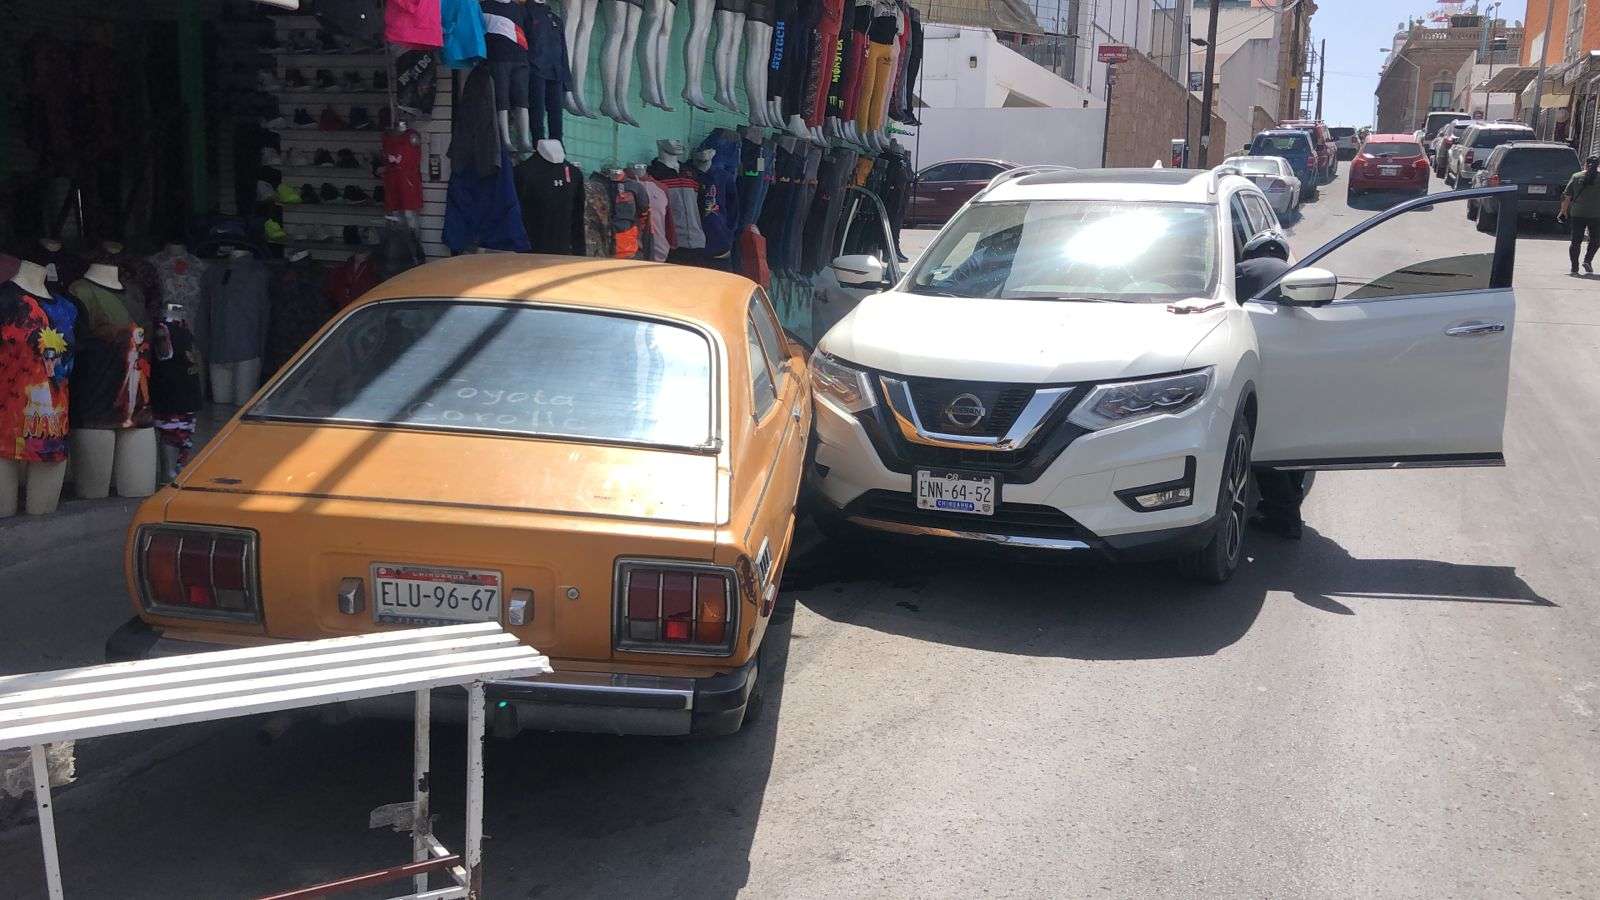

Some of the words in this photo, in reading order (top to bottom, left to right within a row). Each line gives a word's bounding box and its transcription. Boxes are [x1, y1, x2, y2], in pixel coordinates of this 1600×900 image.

[832, 39, 844, 83] MONSTER
[920, 481, 991, 503] ENN-64-52
[381, 581, 497, 612] ELU-96-67
